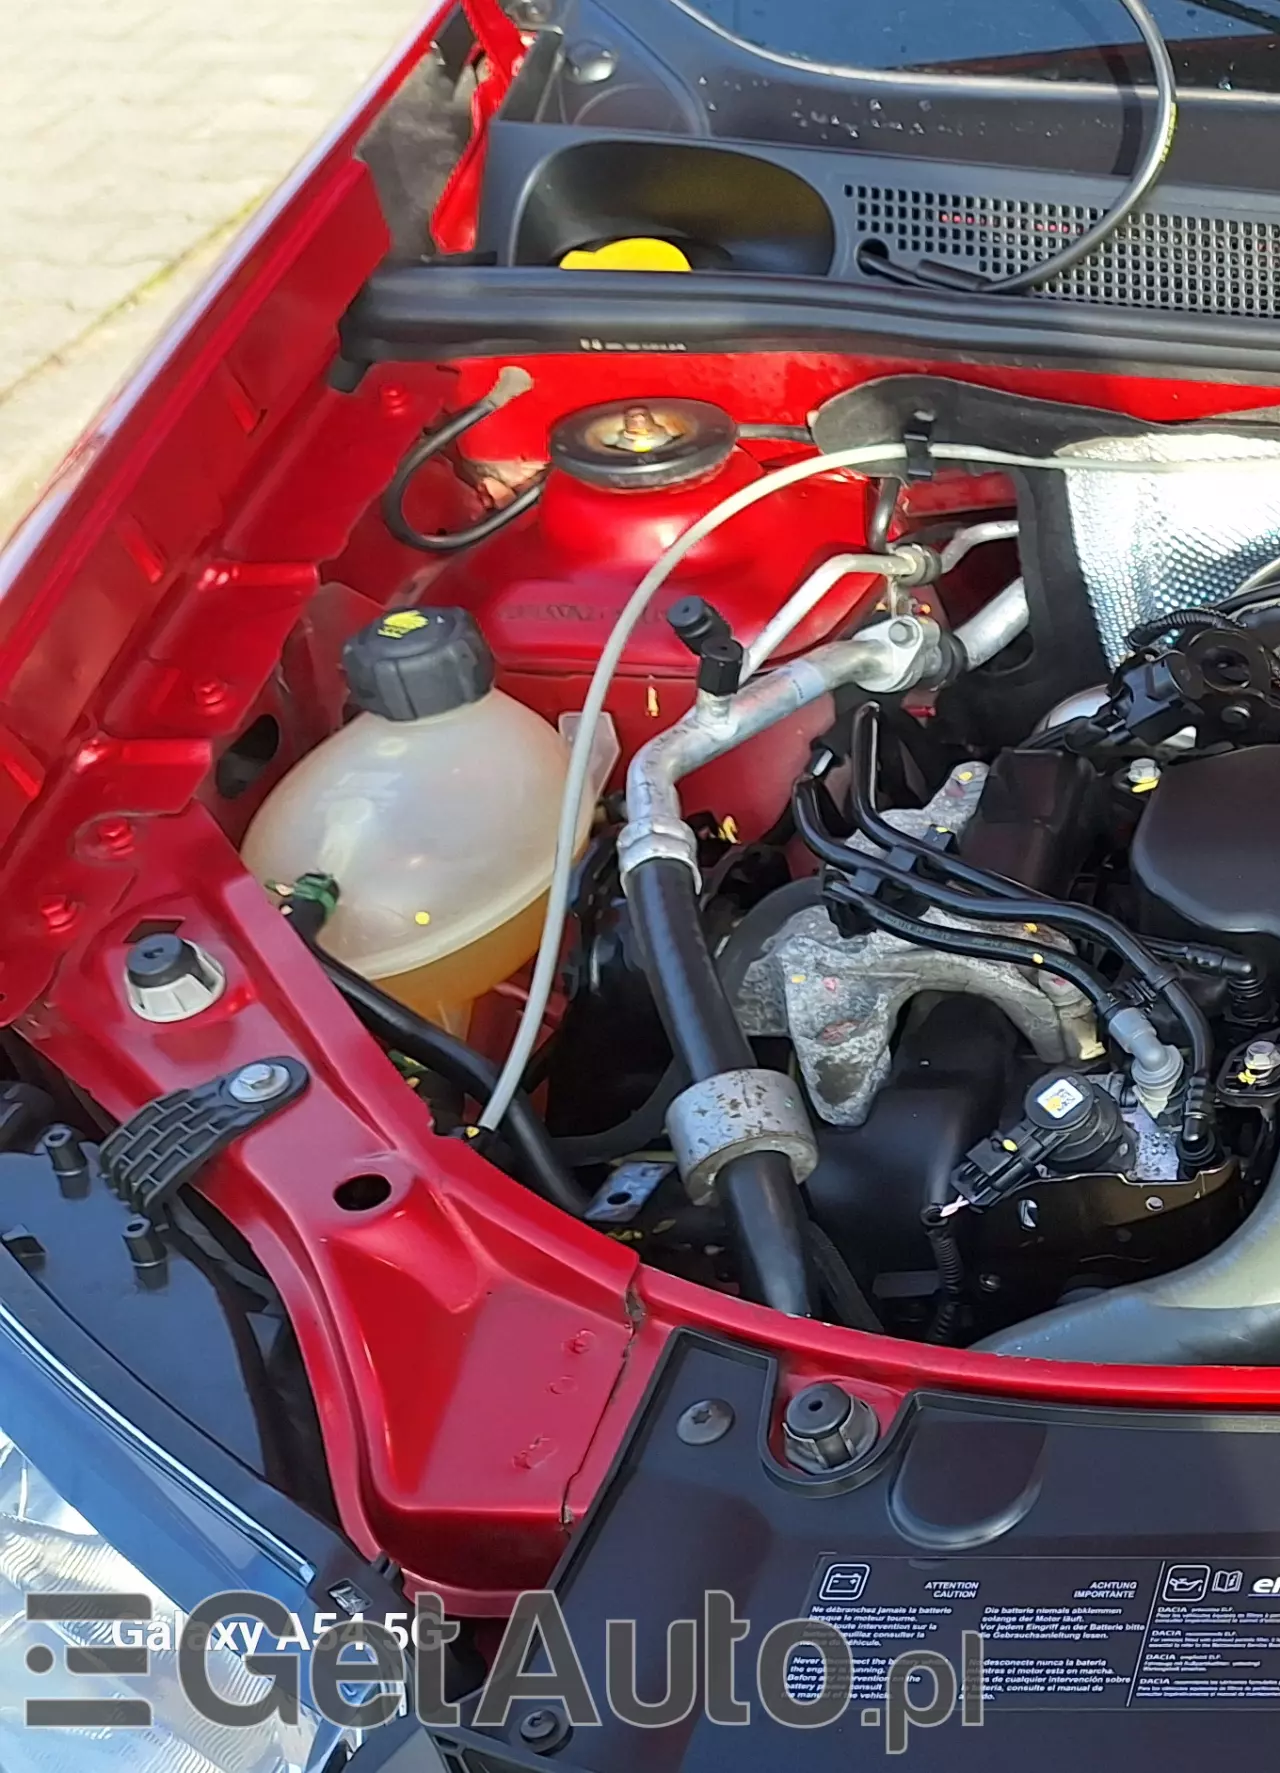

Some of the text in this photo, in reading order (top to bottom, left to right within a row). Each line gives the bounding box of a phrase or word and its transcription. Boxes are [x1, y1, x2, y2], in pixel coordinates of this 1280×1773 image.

[924, 1581, 979, 1589] ATTENTION
[933, 1590, 976, 1598] CAUTION
[1073, 1590, 1135, 1598] IMPORTANTE
[876, 1607, 906, 1615] jamais
[997, 1624, 1024, 1632] jedem
[1026, 1624, 1059, 1632] Eingriff
[993, 1632, 1080, 1640] Gebrauchsanleitung
